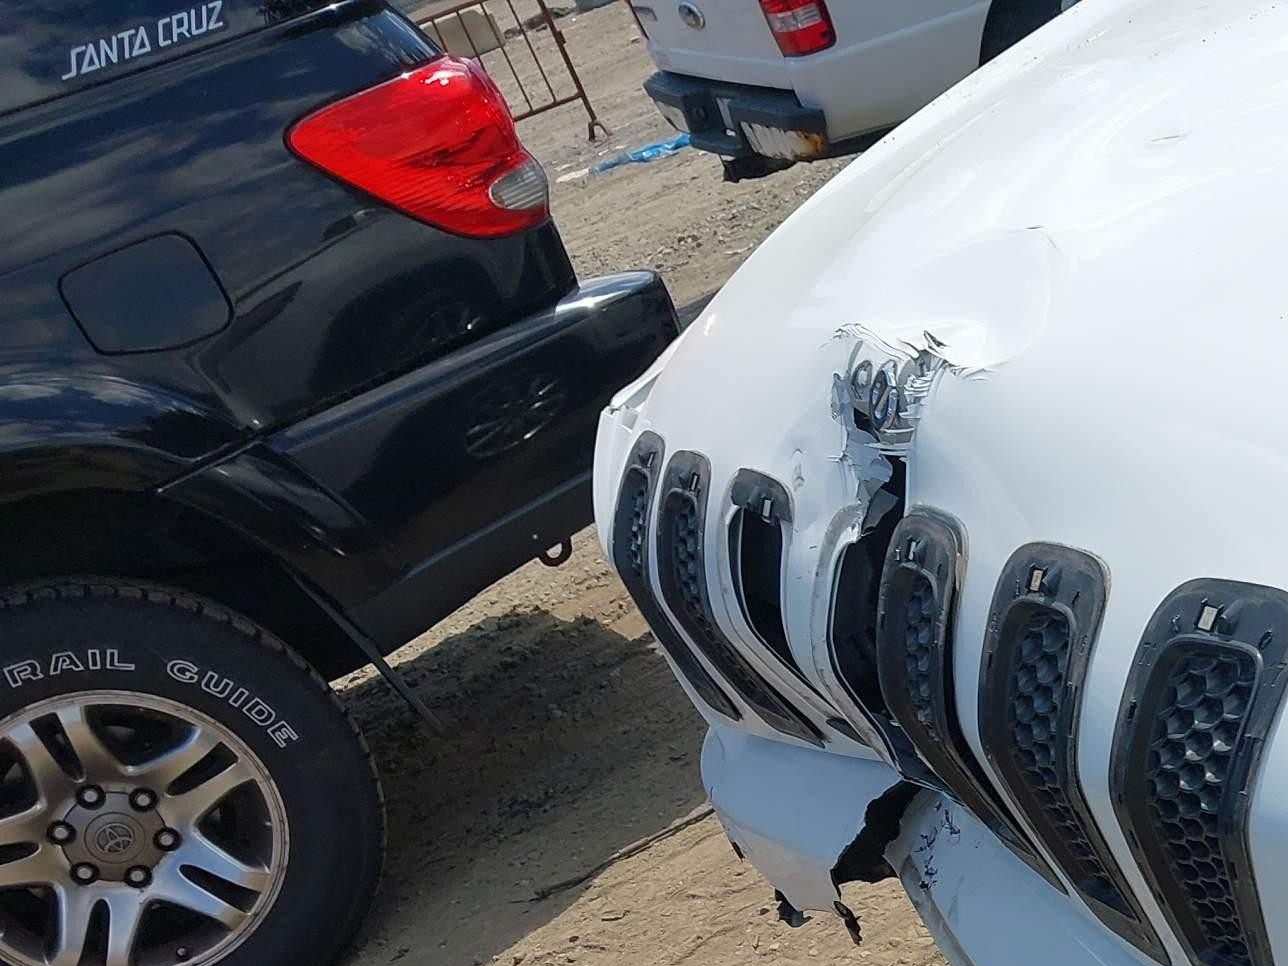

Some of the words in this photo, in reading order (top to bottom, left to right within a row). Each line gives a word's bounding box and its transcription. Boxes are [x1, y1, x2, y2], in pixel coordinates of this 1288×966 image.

[61, 25, 152, 81] SANTA
[157, 0, 224, 47] CRUZ
[2, 648, 136, 688] RAIL
[166, 659, 299, 748] GUIDE
